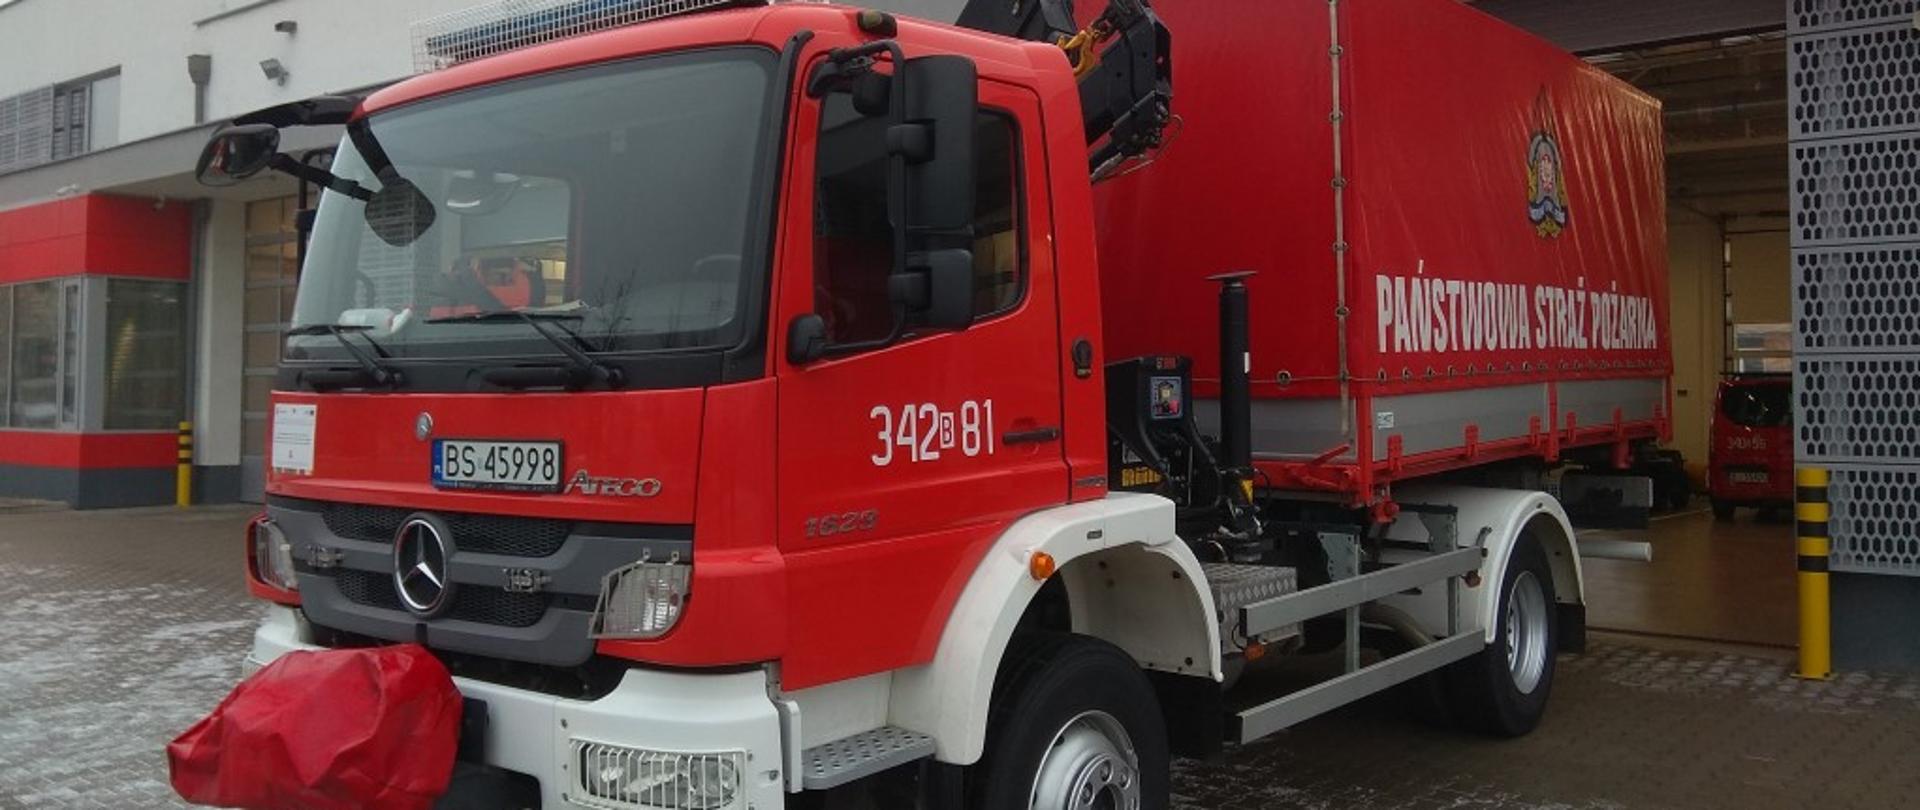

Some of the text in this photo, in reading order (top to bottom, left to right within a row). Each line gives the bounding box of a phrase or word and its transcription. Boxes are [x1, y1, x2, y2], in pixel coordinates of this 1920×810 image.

[1376, 260, 1658, 353] PAŃSTWOWA STRAŻ POŻARNA
[446, 444, 556, 481] BS 45998
[870, 403, 940, 466] 342
[960, 399, 993, 457] 81
